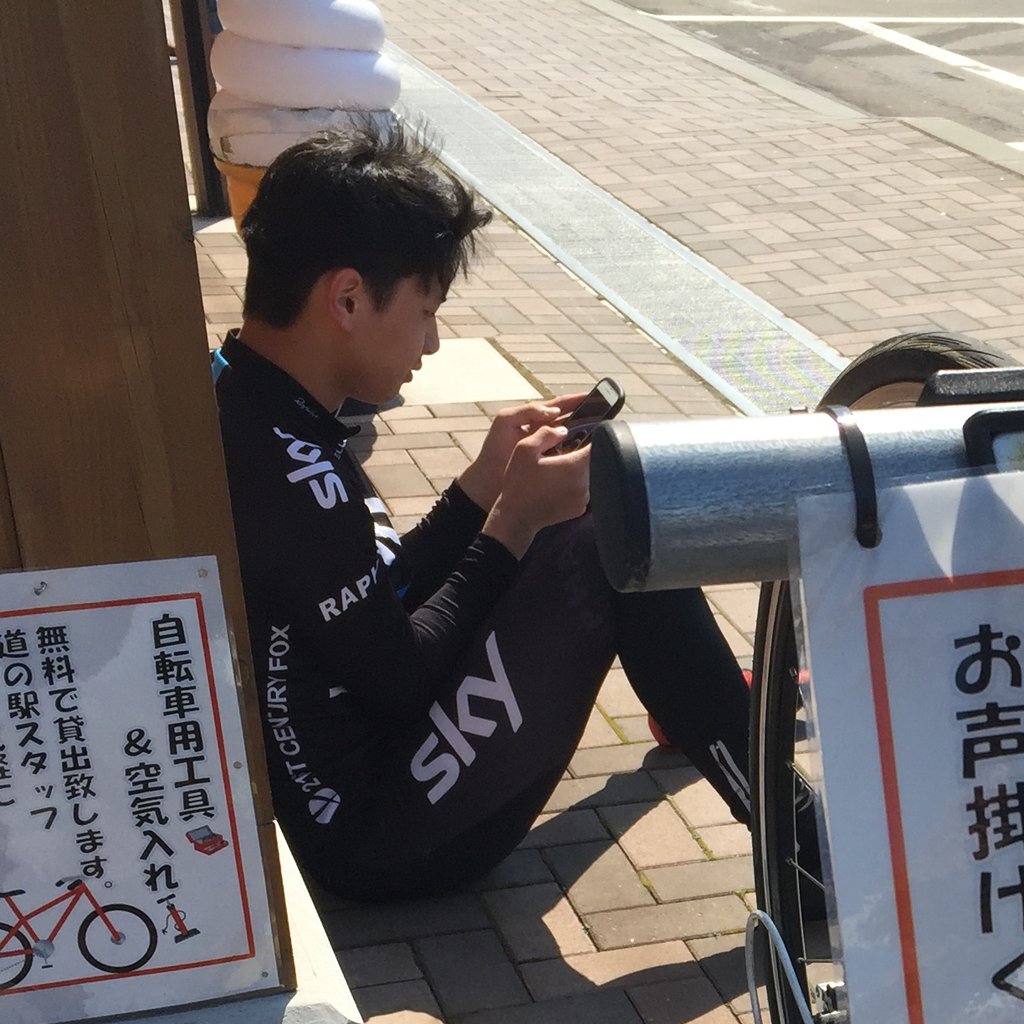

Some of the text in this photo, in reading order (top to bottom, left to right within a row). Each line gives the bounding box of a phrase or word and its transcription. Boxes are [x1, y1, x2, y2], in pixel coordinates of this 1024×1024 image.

[152, 613, 215, 822] 自転車用工具
[268, 624, 290, 671] FOX
[36, 625, 113, 889] 無料で貸出致します。
